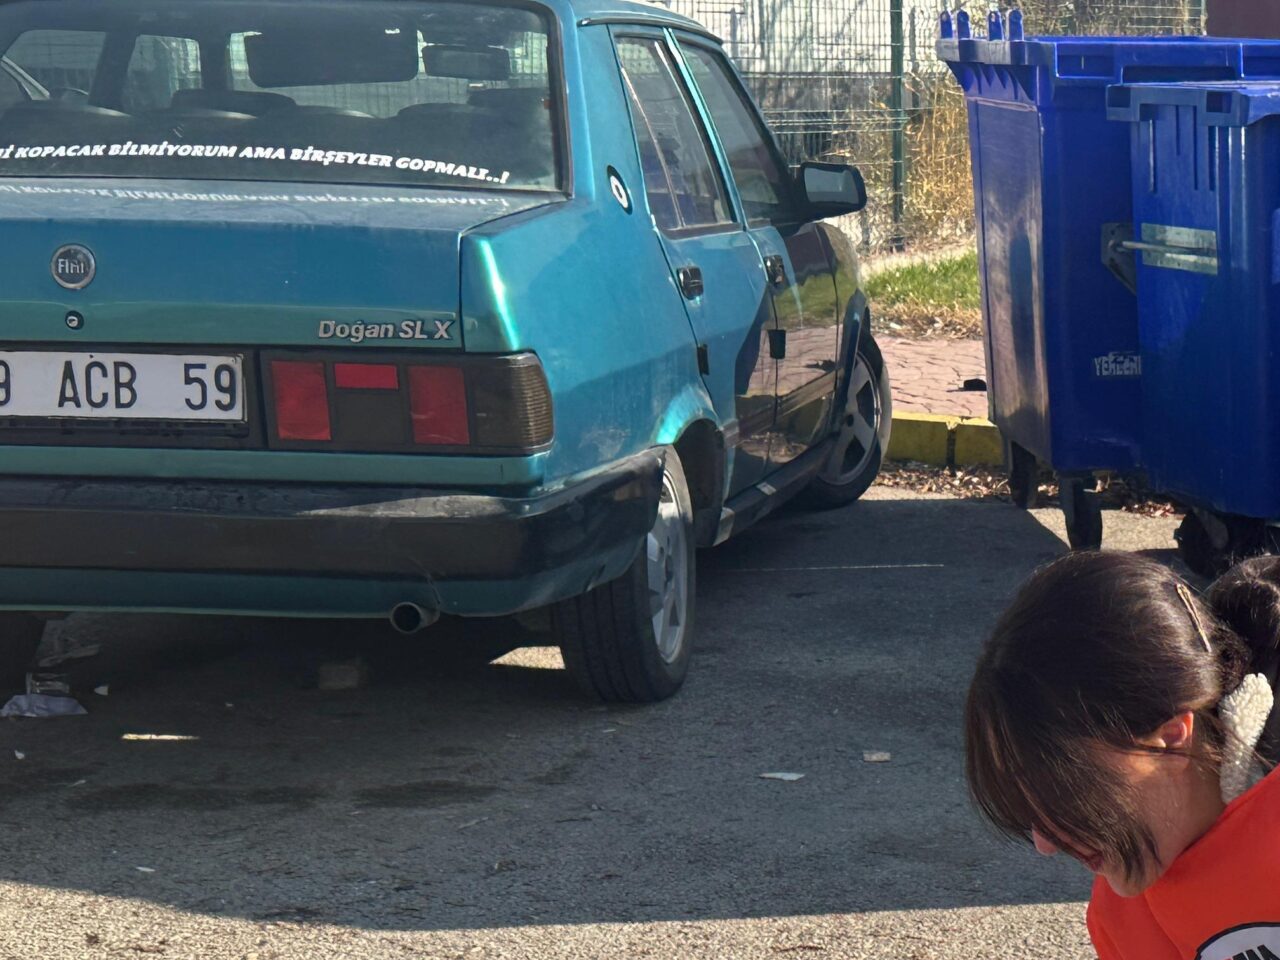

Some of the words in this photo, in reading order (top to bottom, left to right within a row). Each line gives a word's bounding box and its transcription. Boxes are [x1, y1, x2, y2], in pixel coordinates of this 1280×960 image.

[14, 144, 107, 159] KOPACAK
[108, 141, 238, 158] BİLMİYORUM
[239, 146, 286, 160] AMA
[290, 146, 393, 168] BİRŞEYLER
[57, 360, 138, 409] ACB
[184, 362, 237, 412] 59
